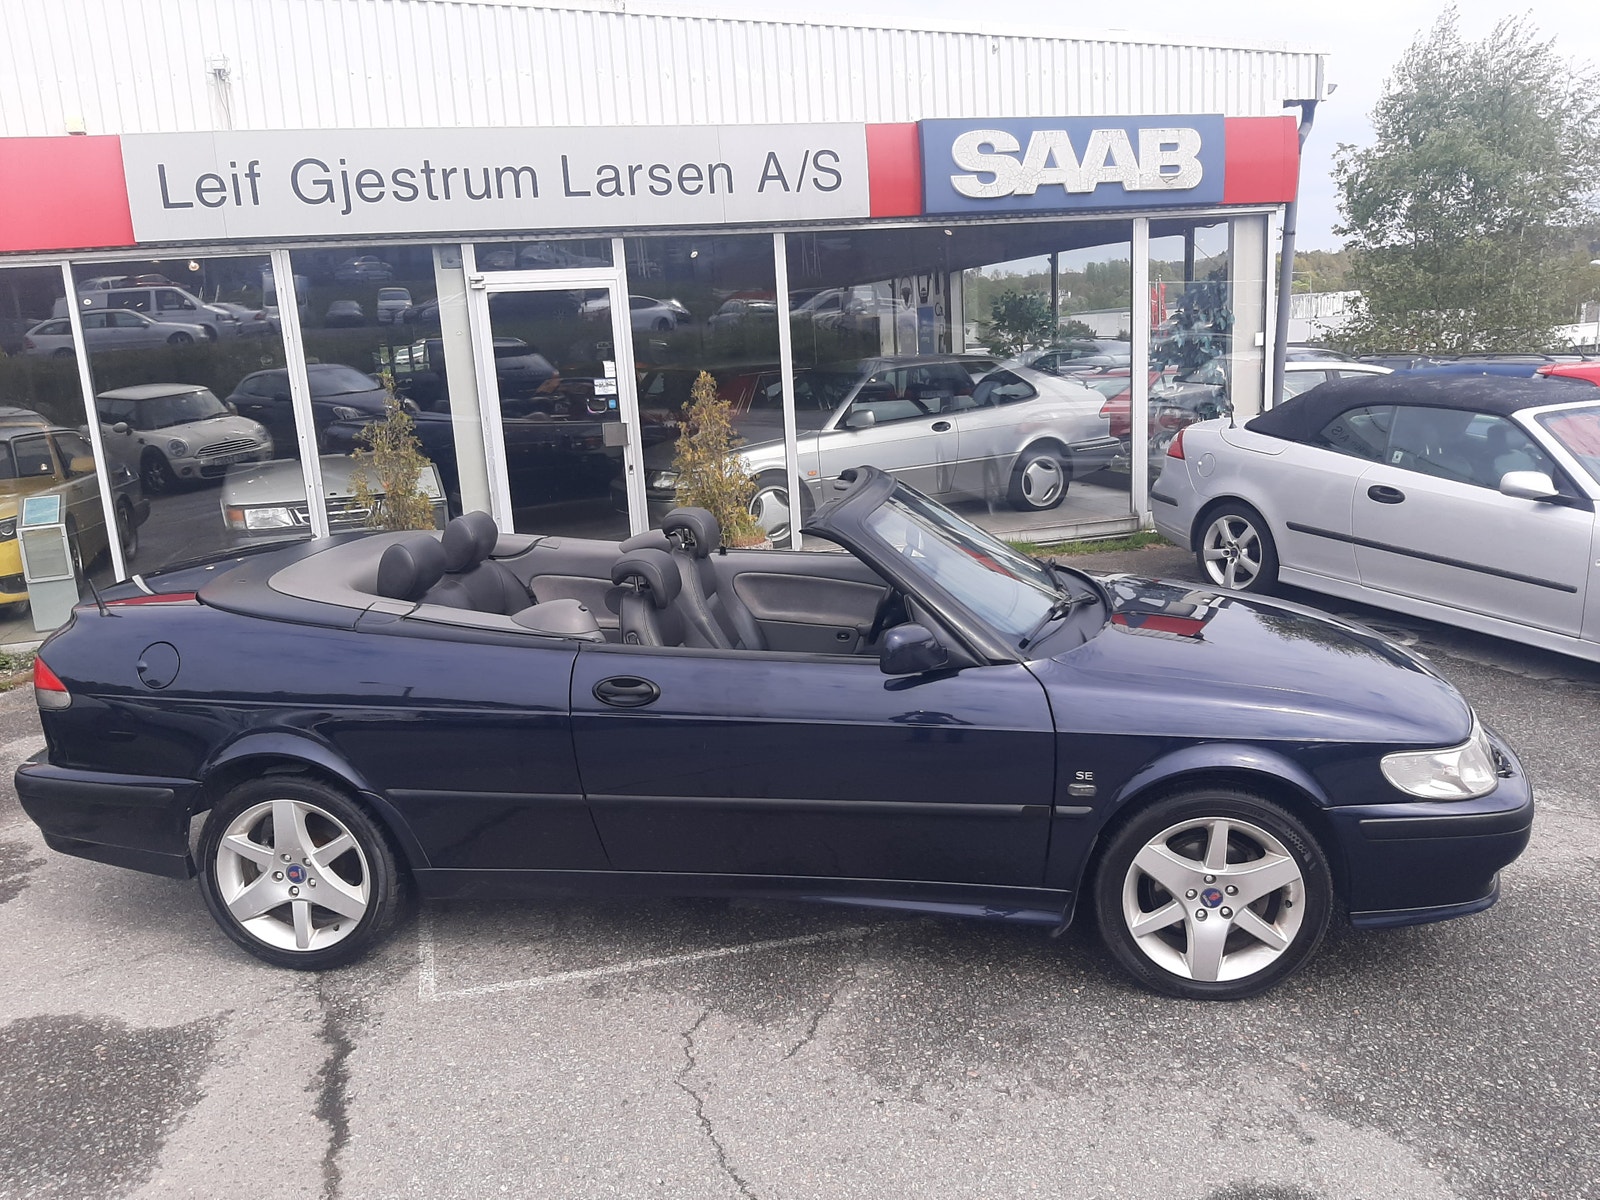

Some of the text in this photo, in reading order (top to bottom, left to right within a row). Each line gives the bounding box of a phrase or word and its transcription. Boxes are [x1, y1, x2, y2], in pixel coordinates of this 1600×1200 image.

[157, 149, 842, 215] Leif Gjestrum Larsen A/S
[950, 127, 1203, 198] SAAB
[1075, 771, 1094, 781] SE
